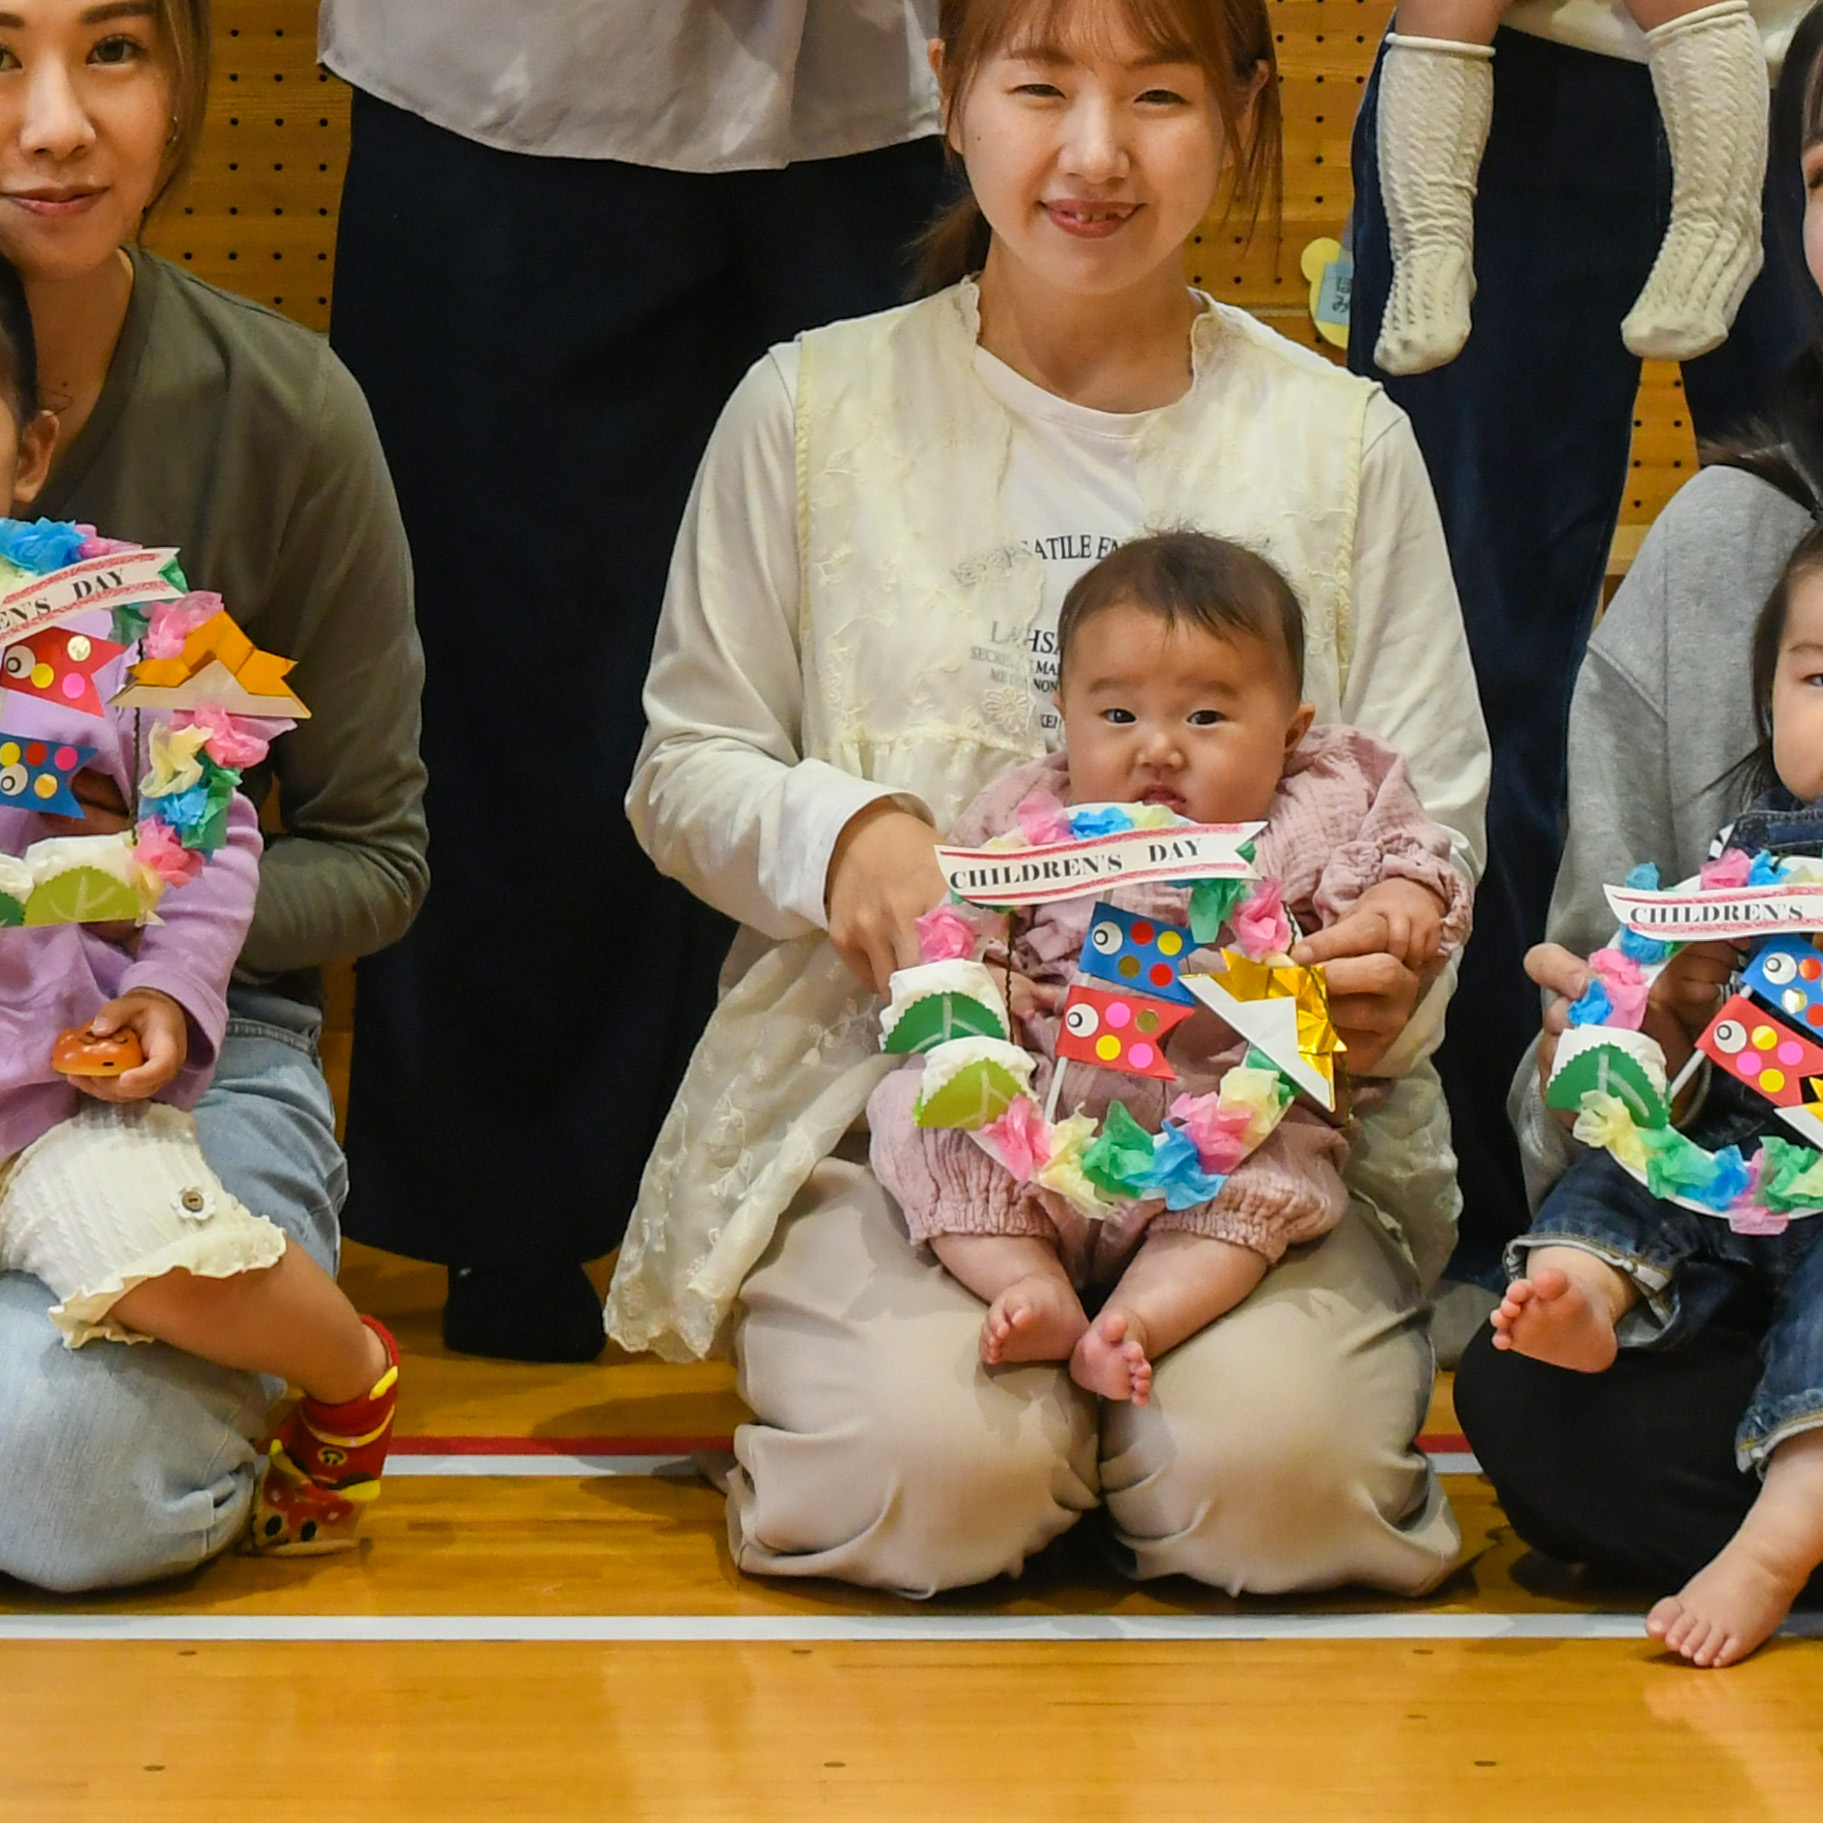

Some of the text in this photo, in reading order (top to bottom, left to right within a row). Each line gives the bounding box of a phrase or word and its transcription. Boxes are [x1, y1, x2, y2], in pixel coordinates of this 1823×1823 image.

[72, 567, 125, 600] DAY
[950, 839, 1200, 889] CHILDREN'S DAY
[1630, 903, 1804, 924] CHILDREN'S
